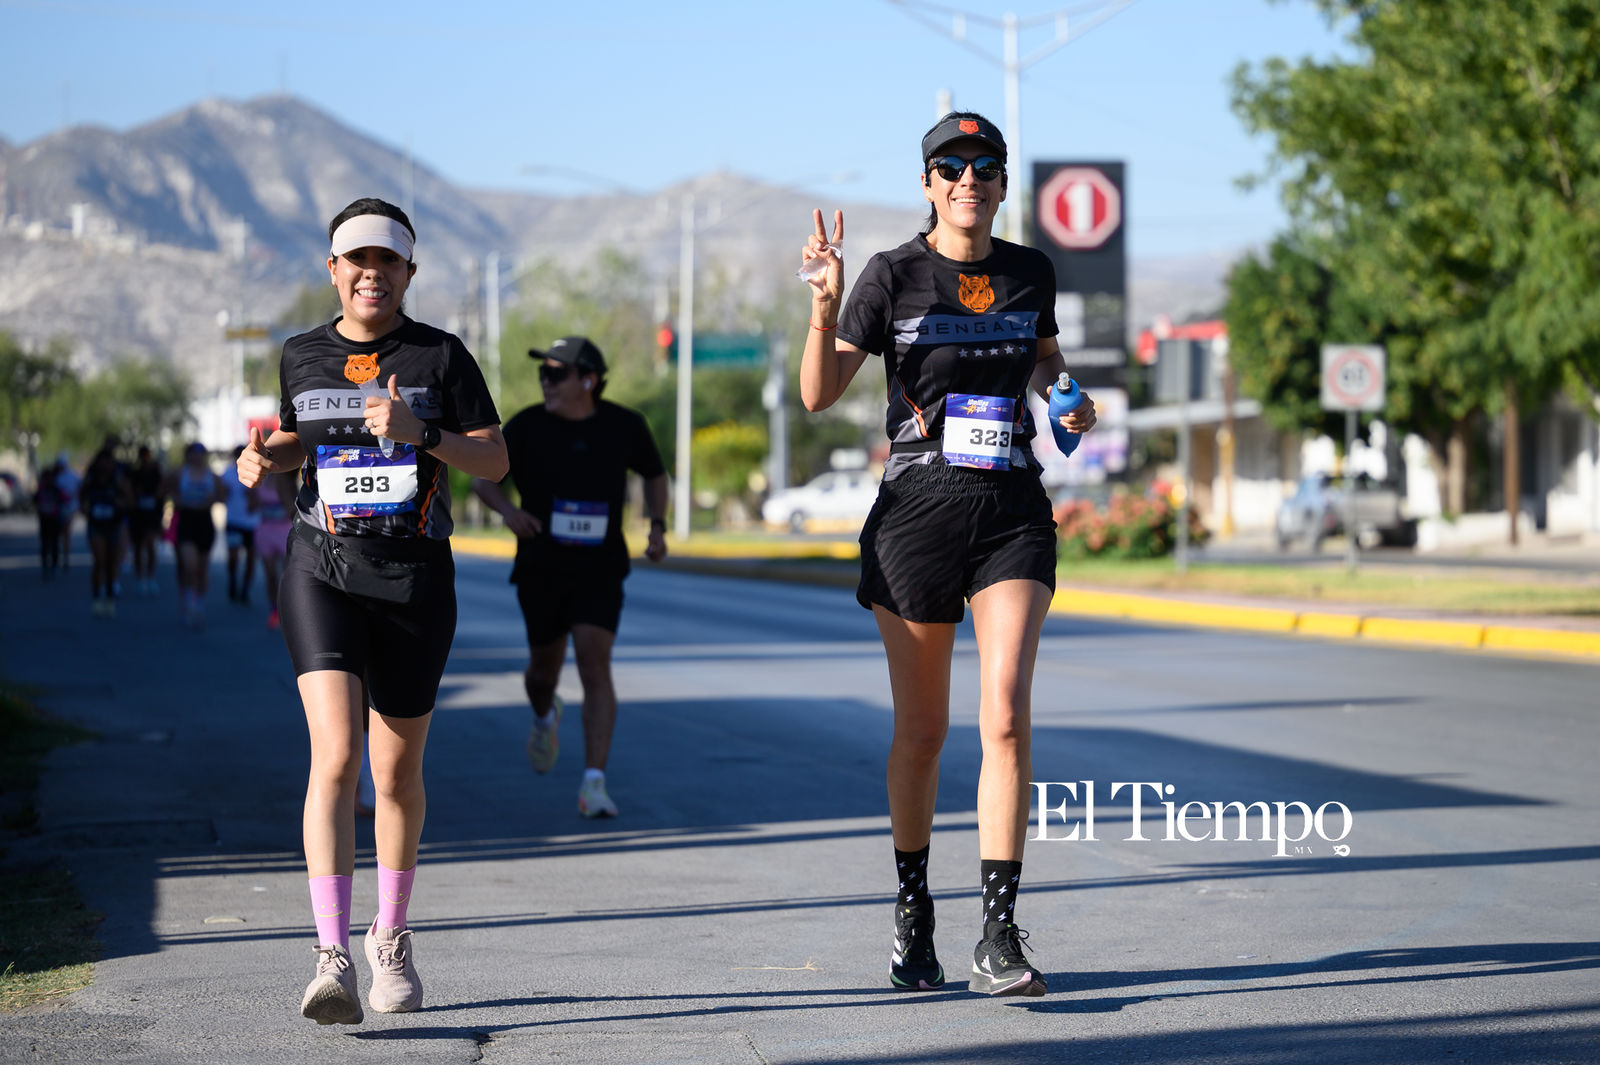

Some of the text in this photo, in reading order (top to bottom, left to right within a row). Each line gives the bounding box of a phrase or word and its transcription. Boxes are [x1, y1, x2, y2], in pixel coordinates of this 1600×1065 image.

[917, 319, 1037, 336] BENGALA
[297, 392, 438, 412] BENGAS
[970, 428, 1010, 447] 323
[345, 476, 390, 493] 293
